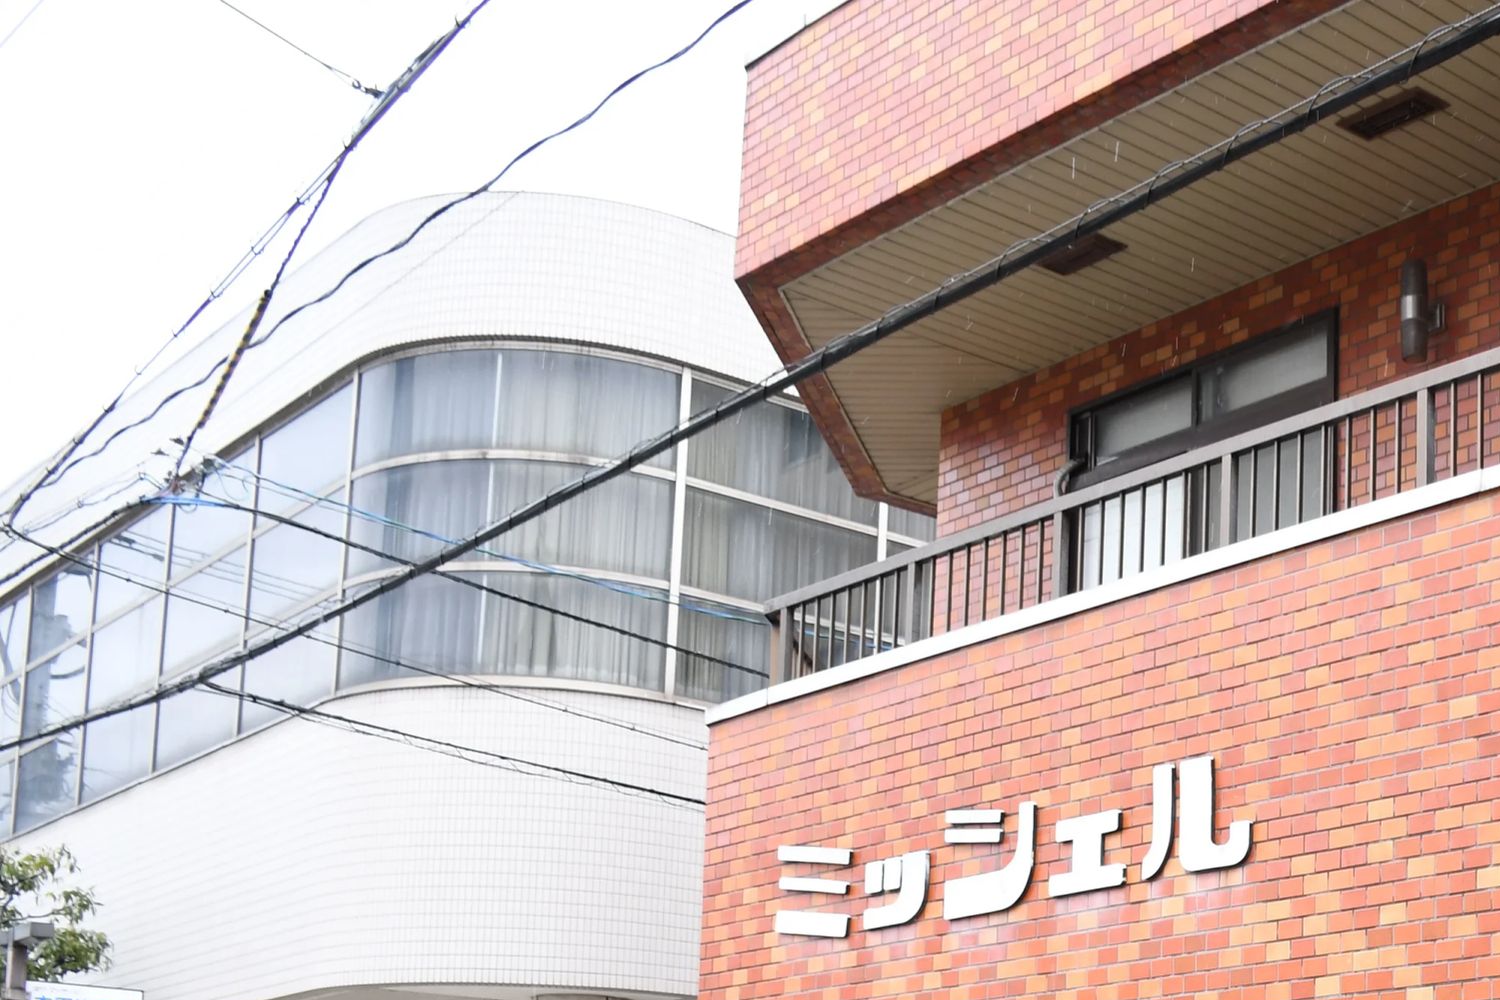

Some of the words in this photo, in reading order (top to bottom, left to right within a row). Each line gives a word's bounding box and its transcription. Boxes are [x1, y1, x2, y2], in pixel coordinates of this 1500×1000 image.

[775, 755, 1254, 938] ミッシェル
